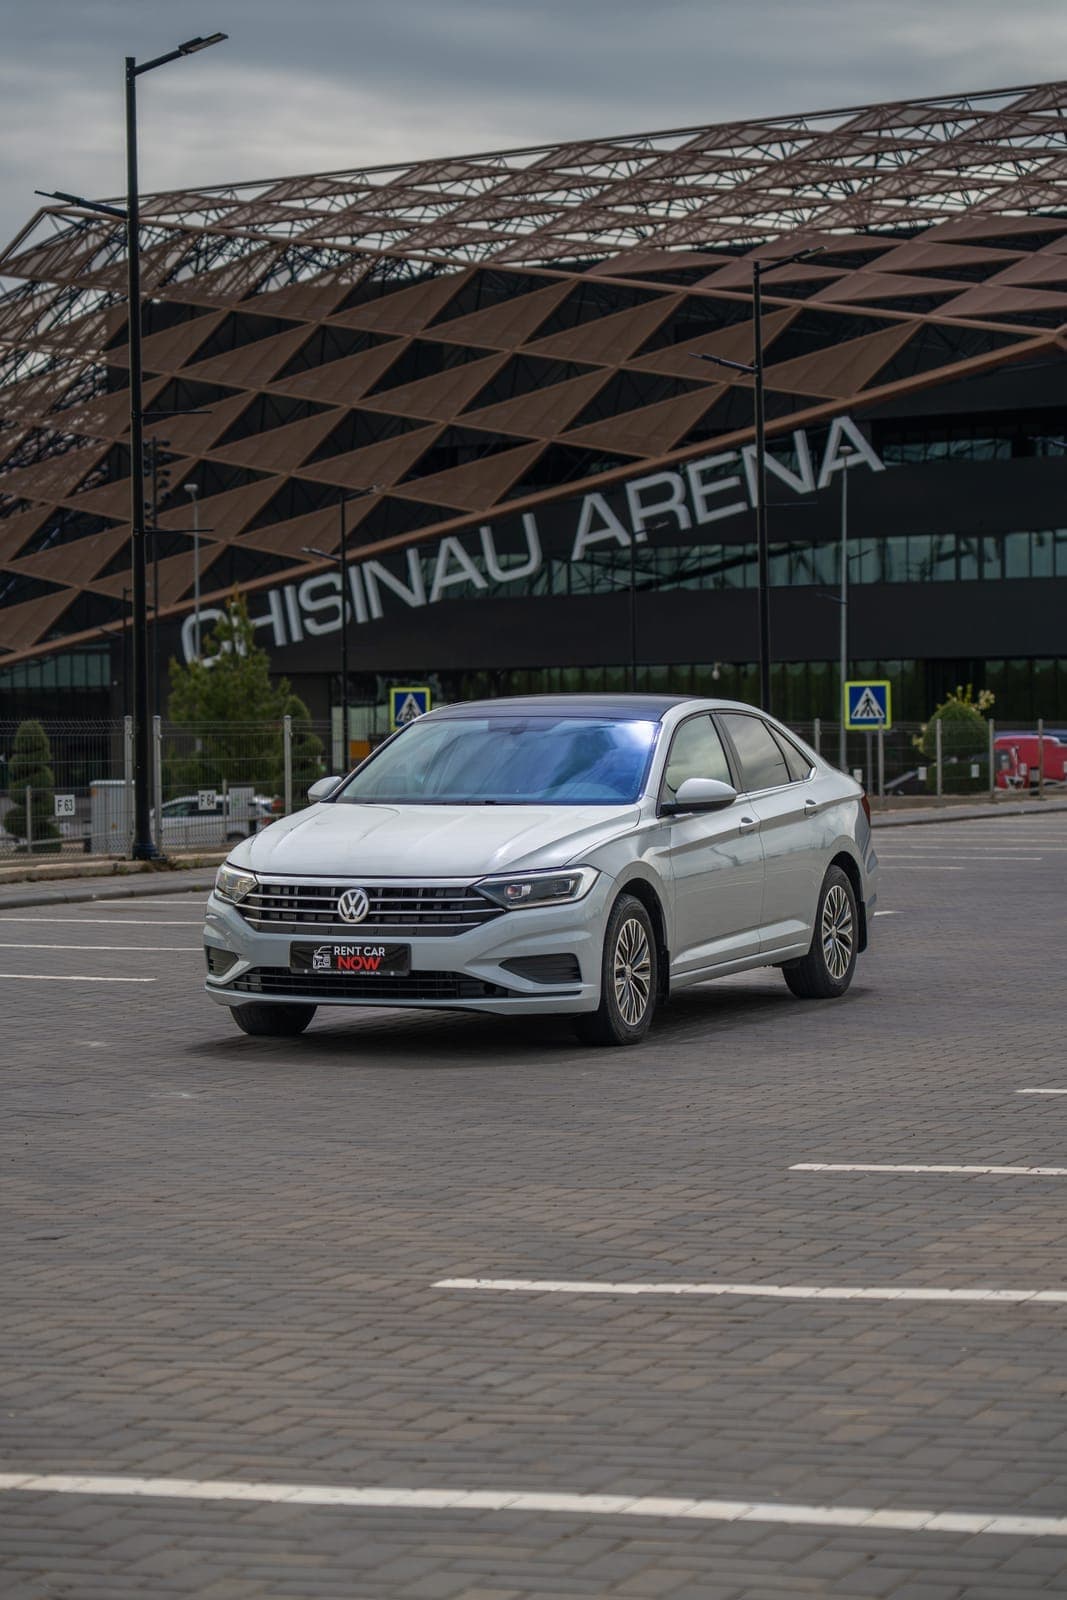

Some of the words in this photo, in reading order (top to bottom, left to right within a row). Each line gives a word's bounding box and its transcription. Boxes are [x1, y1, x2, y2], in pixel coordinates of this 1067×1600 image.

[181, 513, 542, 667] CHISINAU
[571, 416, 885, 561] ARENA
[64, 799, 73, 811] 63
[333, 946, 361, 956] RENT
[363, 946, 385, 956] CAR
[337, 956, 381, 970] NOW
